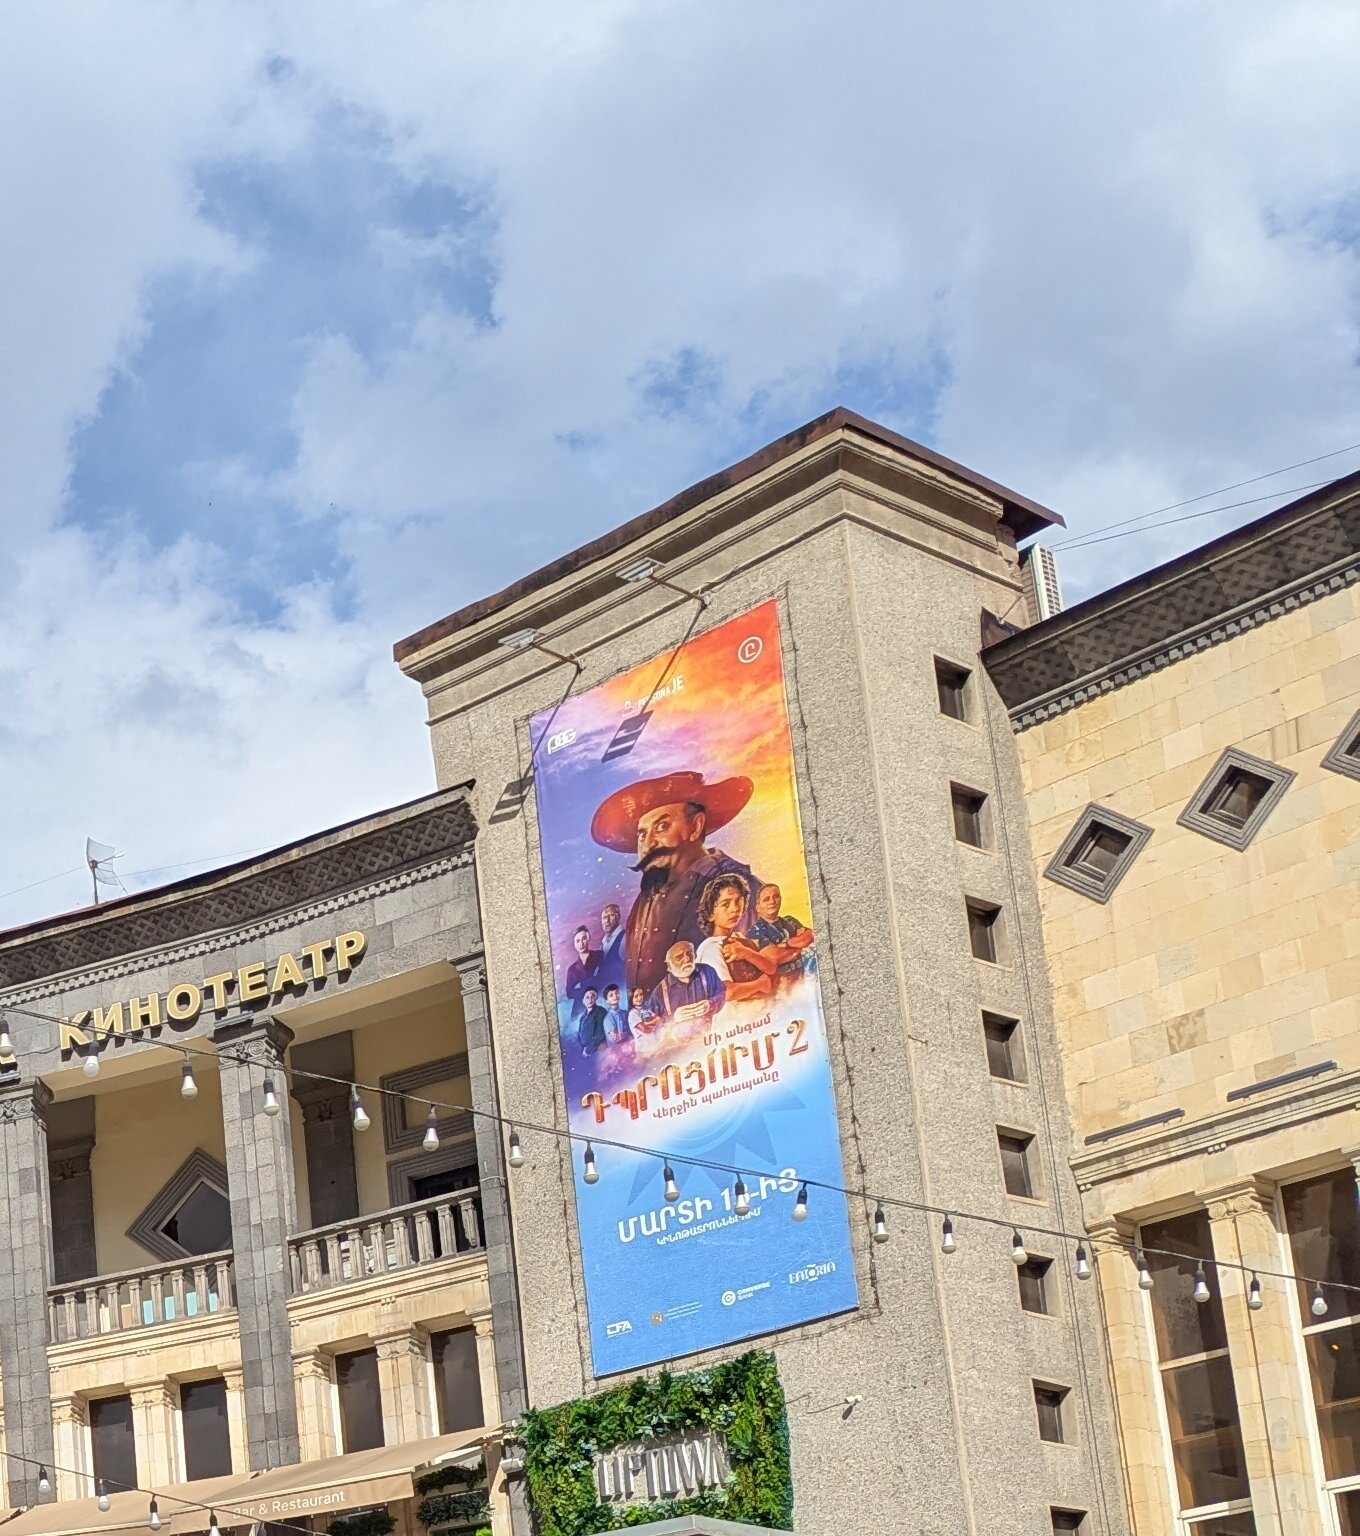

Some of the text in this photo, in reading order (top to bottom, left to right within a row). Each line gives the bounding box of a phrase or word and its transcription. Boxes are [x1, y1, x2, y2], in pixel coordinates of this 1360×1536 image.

[59, 930, 370, 1051] КИНОТЕАТР
[581, 1017, 809, 1124] ԴՊՐՈՑՈՒՄ 2
[618, 1196, 713, 1243] ՄԱՐՏԻ
[233, 1490, 345, 1519] Bar & Restaurant
